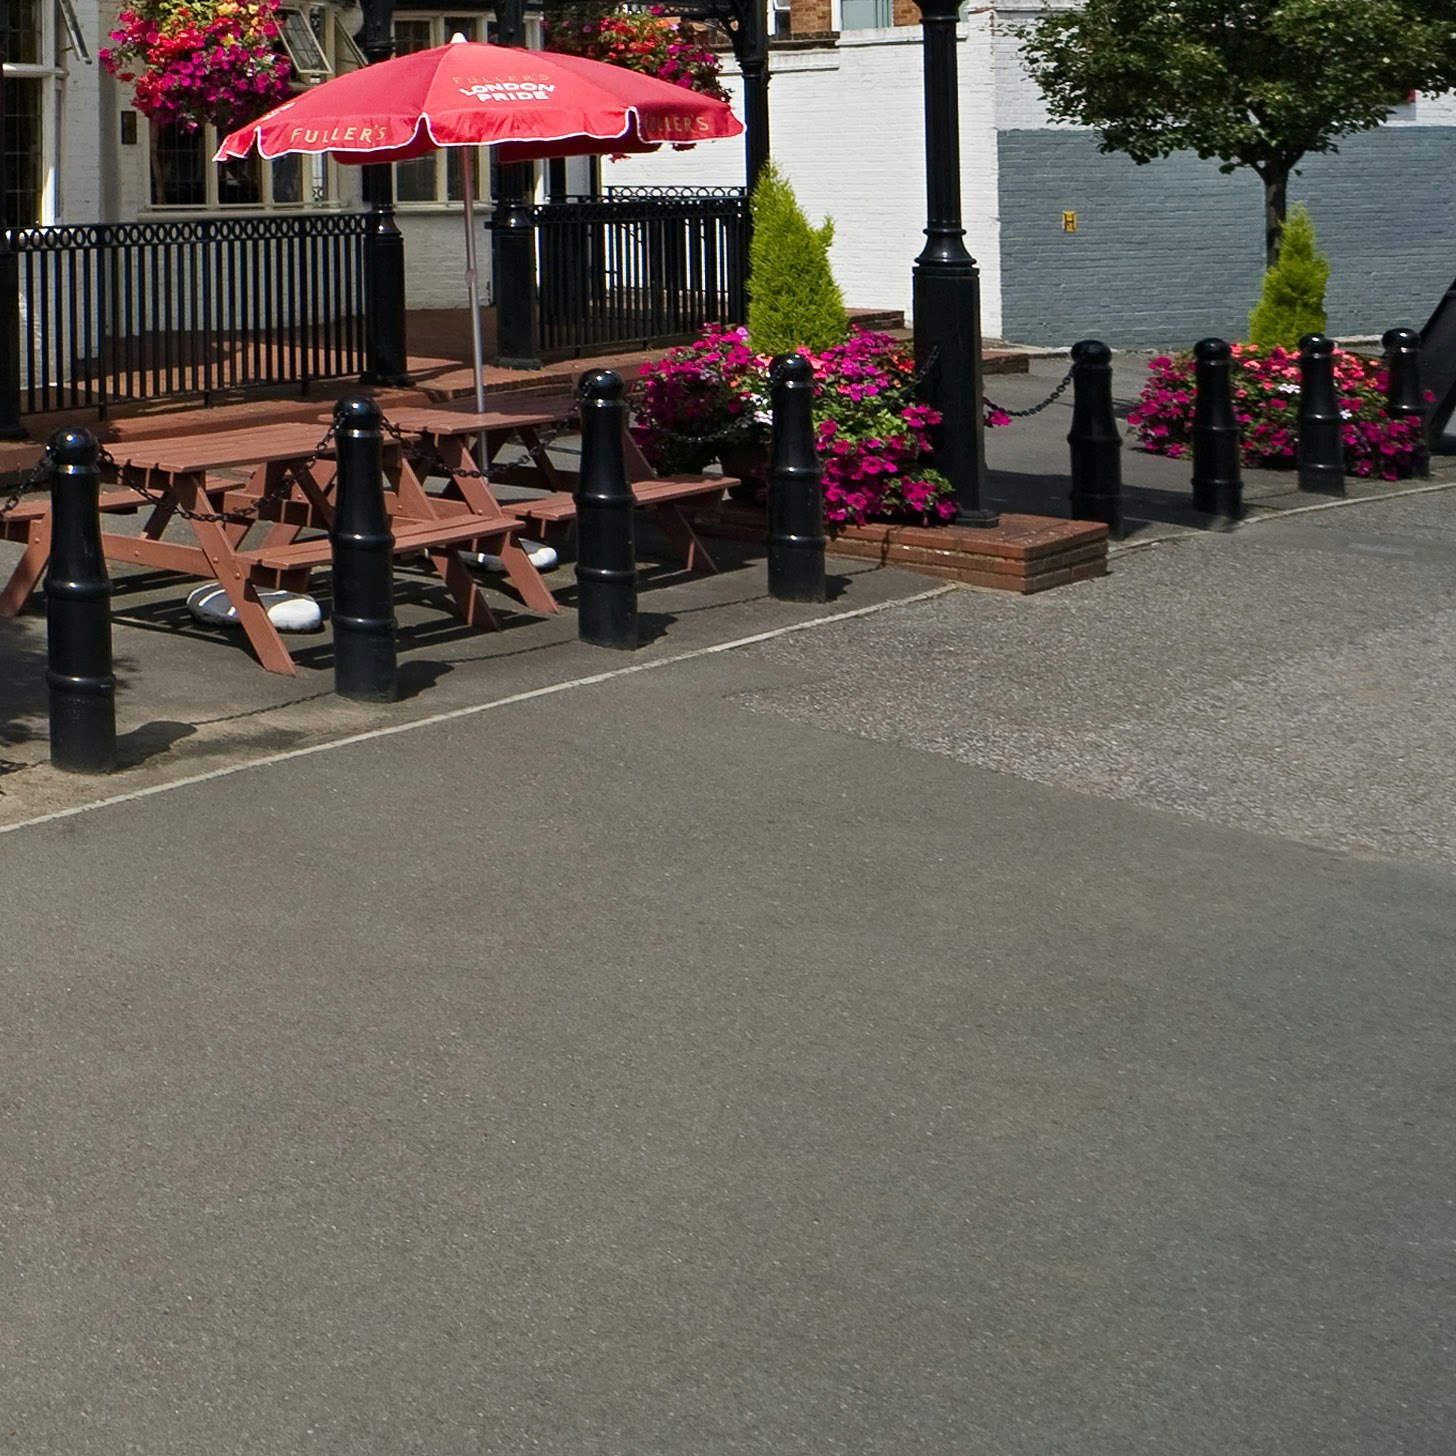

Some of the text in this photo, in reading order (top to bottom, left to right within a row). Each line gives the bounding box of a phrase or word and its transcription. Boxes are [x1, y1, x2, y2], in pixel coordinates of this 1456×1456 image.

[458, 82, 556, 96] LONDON
[477, 91, 551, 102] PRIDE
[290, 124, 386, 144] FULLER'S
